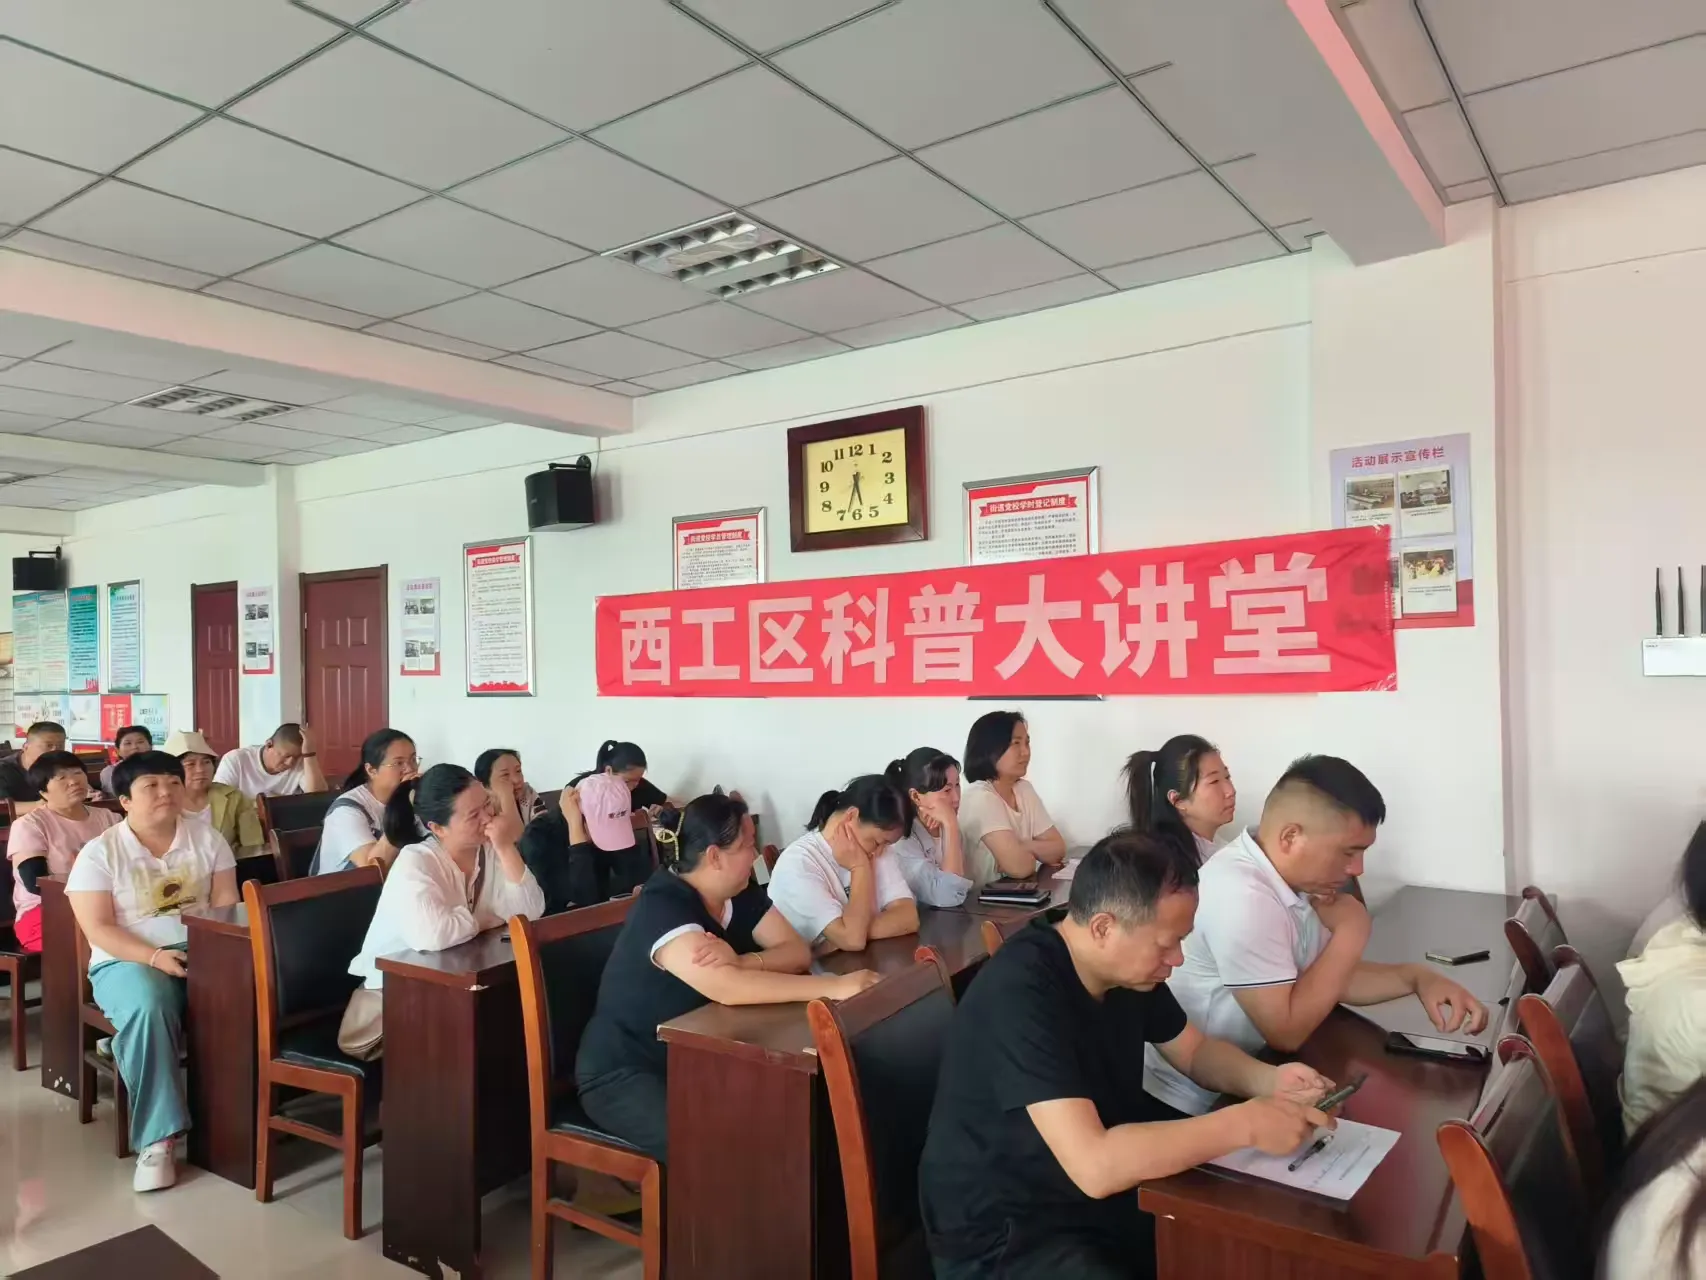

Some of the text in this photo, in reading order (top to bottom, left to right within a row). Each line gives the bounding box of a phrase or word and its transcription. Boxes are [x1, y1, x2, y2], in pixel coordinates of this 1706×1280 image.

[834, 448, 844, 460] 11
[849, 444, 863, 457] 12
[869, 443, 876, 455] 1
[882, 451, 893, 463] 2
[1351, 446, 1445, 468] 活动展示宣传栏
[821, 460, 833, 473] 10
[884, 472, 895, 484] 3
[820, 481, 830, 493] 9
[883, 493, 894, 504] 4
[822, 500, 832, 512] 8
[869, 505, 879, 518] 5
[837, 509, 846, 521] 7
[852, 508, 863, 520] 6
[619, 552, 1331, 686] 西工区科普大讲堂
